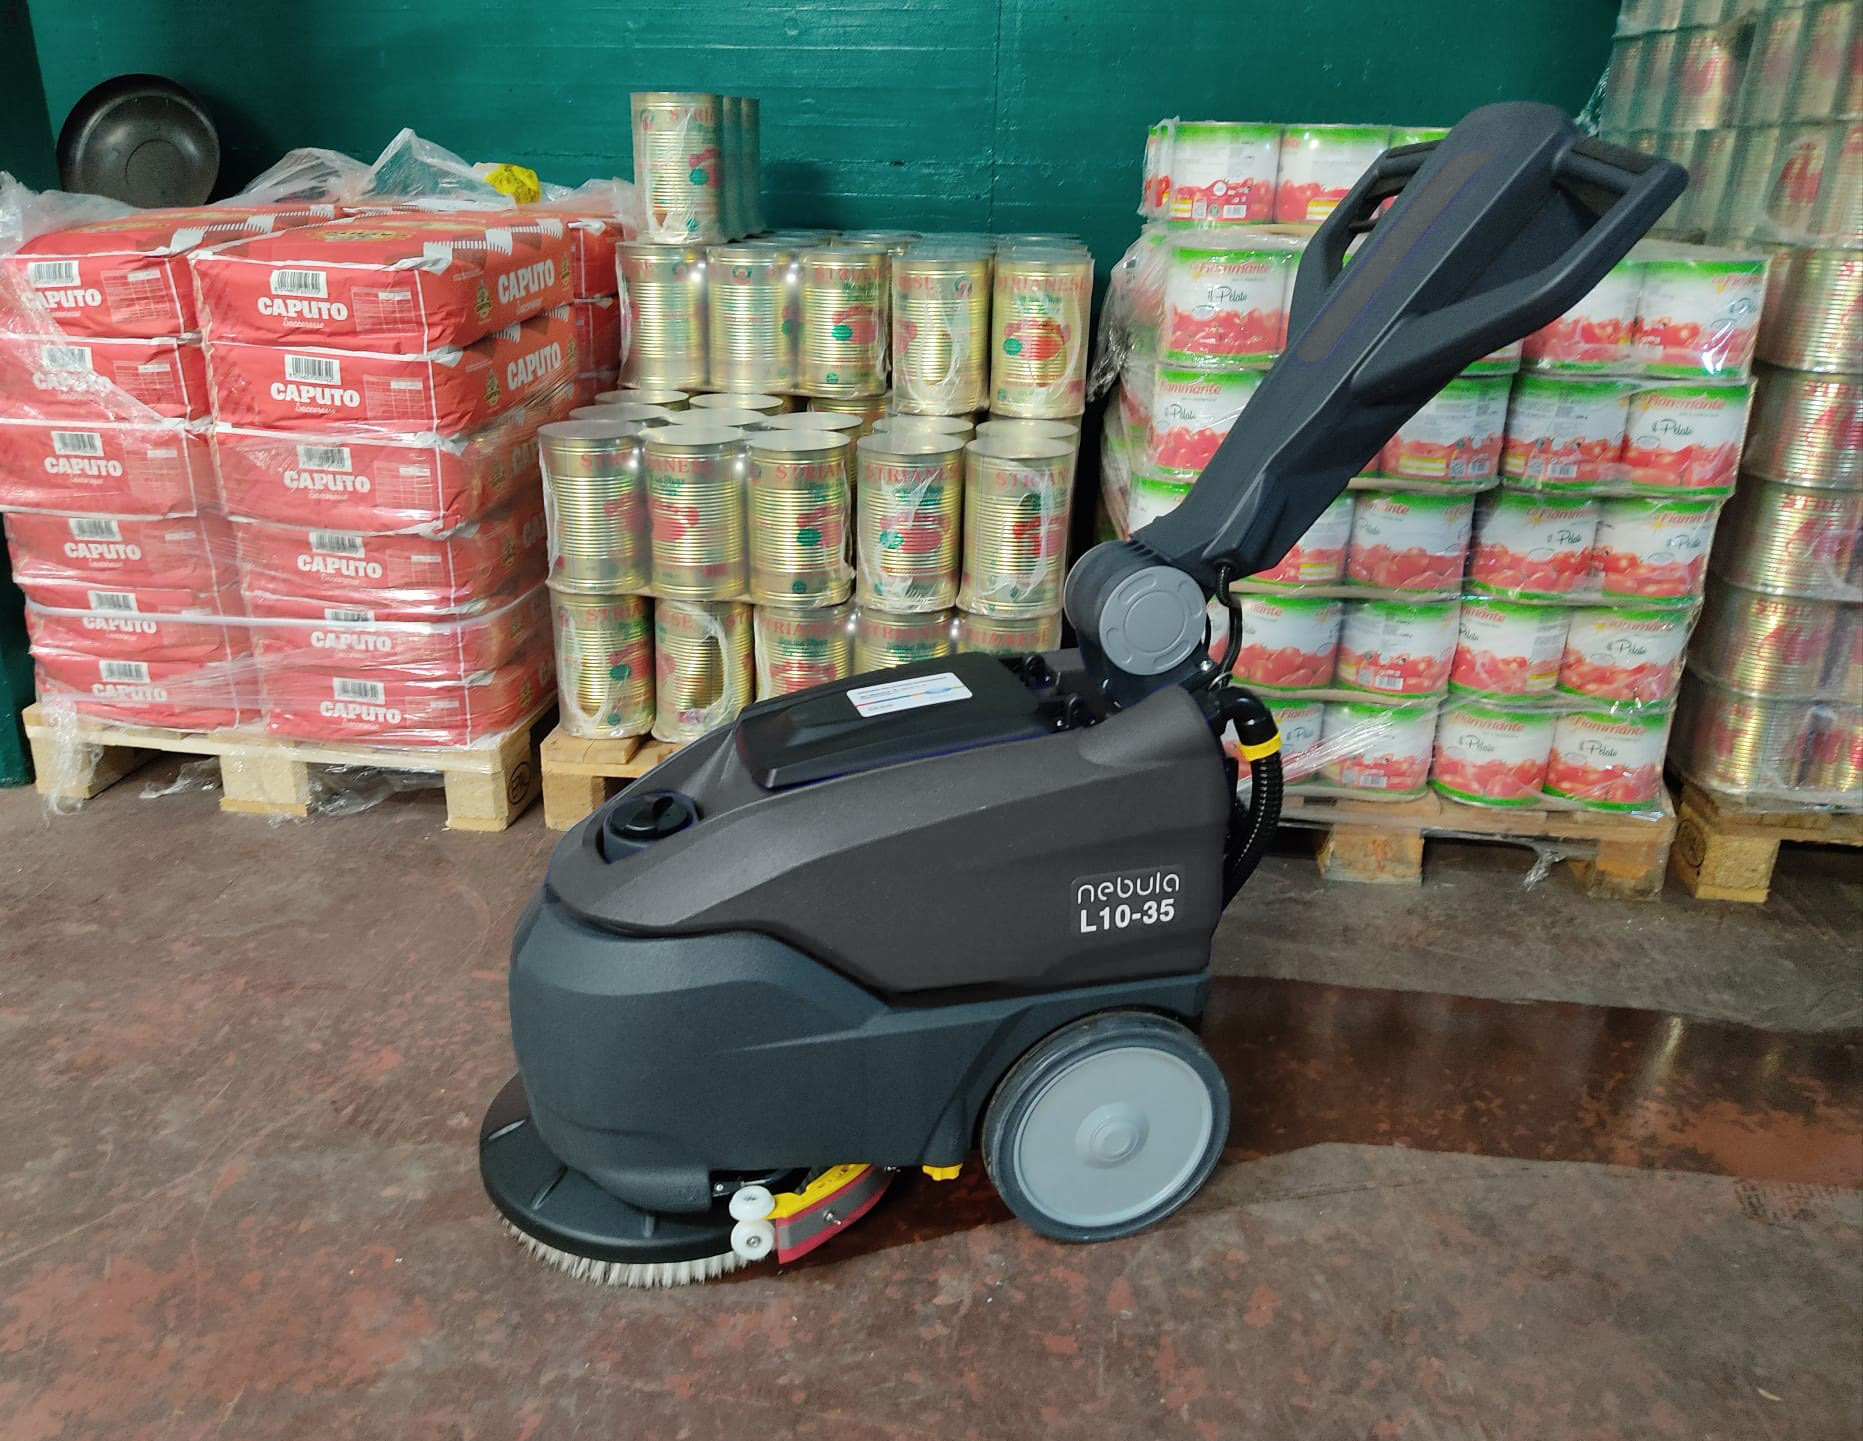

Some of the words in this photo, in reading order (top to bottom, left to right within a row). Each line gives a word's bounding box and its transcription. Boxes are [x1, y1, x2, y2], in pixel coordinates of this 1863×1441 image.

[498, 259, 555, 304] CAPUTO
[21, 288, 102, 310] CAPUTO
[1216, 286, 1248, 303] Pelato
[257, 297, 348, 321] CAPUTO
[507, 342, 561, 391] CAPUTO
[270, 382, 361, 408] CAPUTO
[1660, 418, 1694, 435] Pelato
[44, 457, 123, 477] CAPUTO
[283, 470, 371, 494] CAPUTO
[64, 542, 142, 561] CAPUTO
[297, 554, 383, 579] CAPUTO
[82, 617, 157, 635] CAPUTO
[310, 631, 392, 652] CAPUTO
[92, 683, 168, 702] CAPUTO
[320, 701, 402, 725] CAPUTO
[1077, 871, 1180, 905] nebula
[1080, 898, 1175, 934] L10-35
